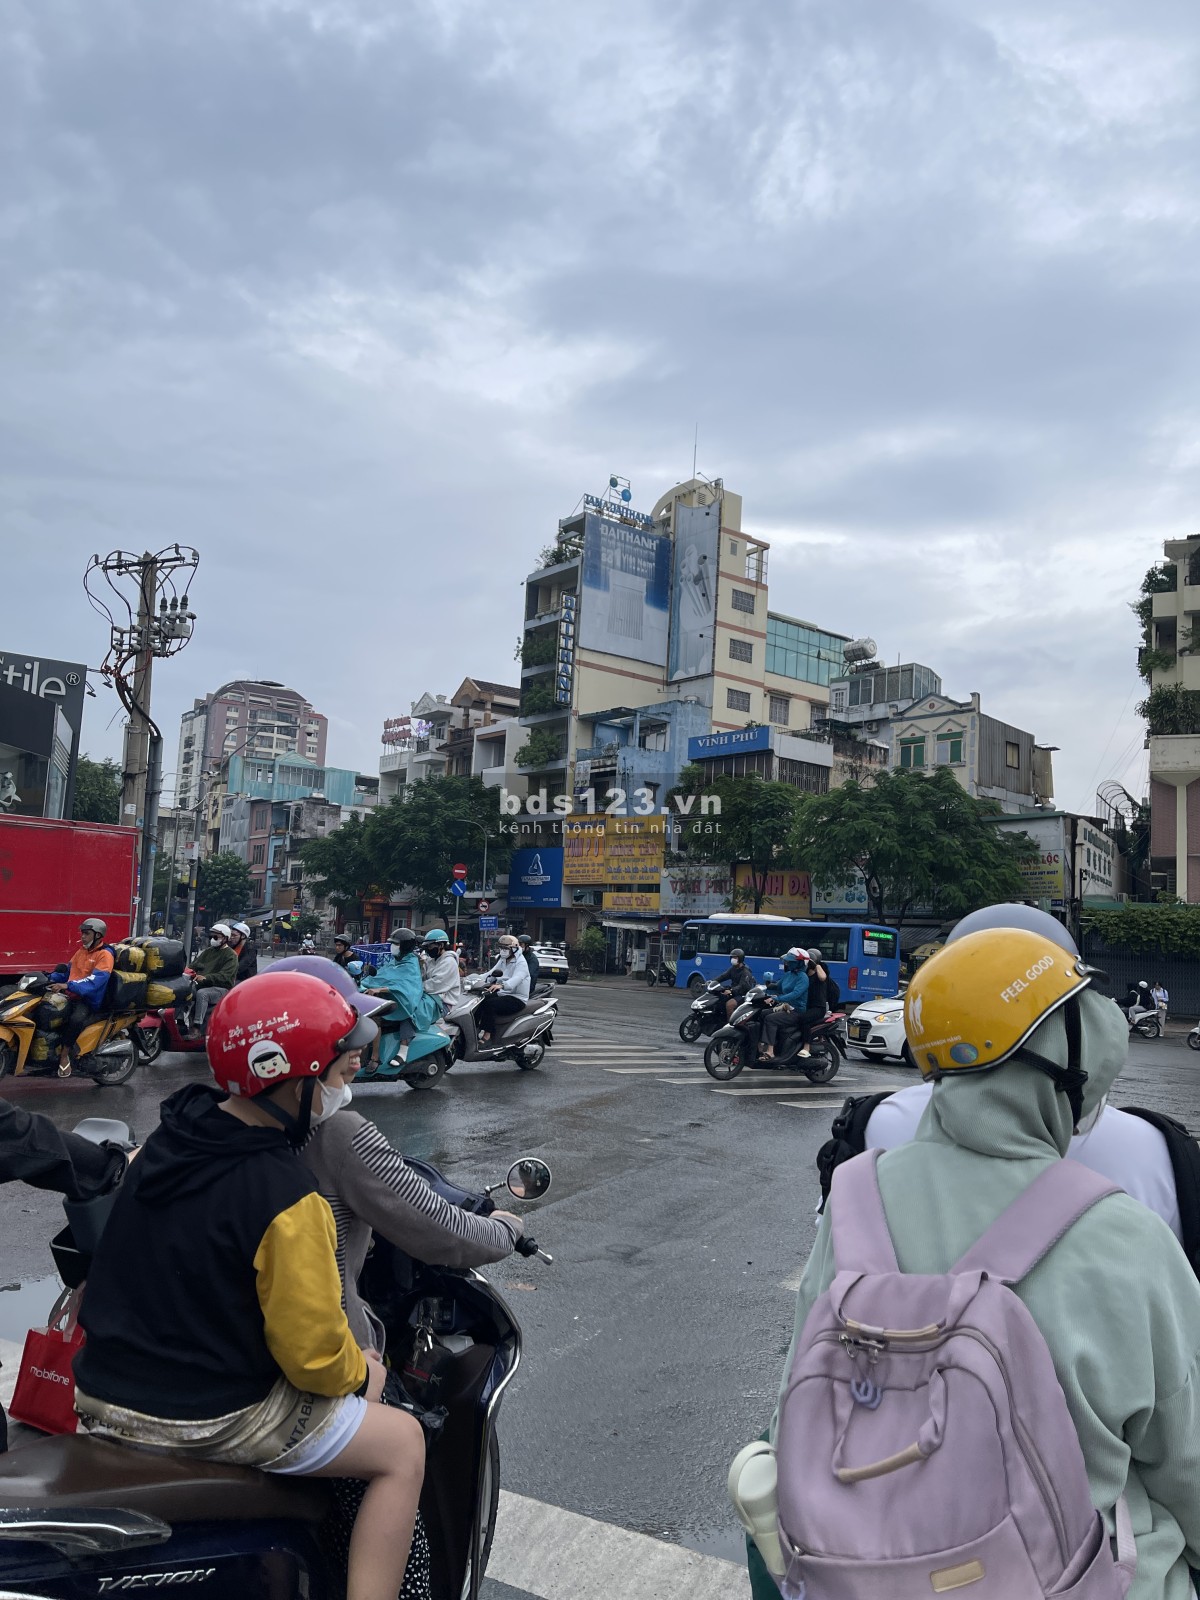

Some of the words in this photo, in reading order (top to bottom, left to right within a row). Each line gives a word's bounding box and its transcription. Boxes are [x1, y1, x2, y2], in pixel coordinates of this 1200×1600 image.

[2, 661, 66, 698] tile
[732, 729, 758, 743] PHÚ
[1000, 978, 1029, 1003] FEEL
[1026, 955, 1054, 981] GOOD
[30, 1365, 70, 1386] mobifone
[98, 1567, 216, 1594] VISION
